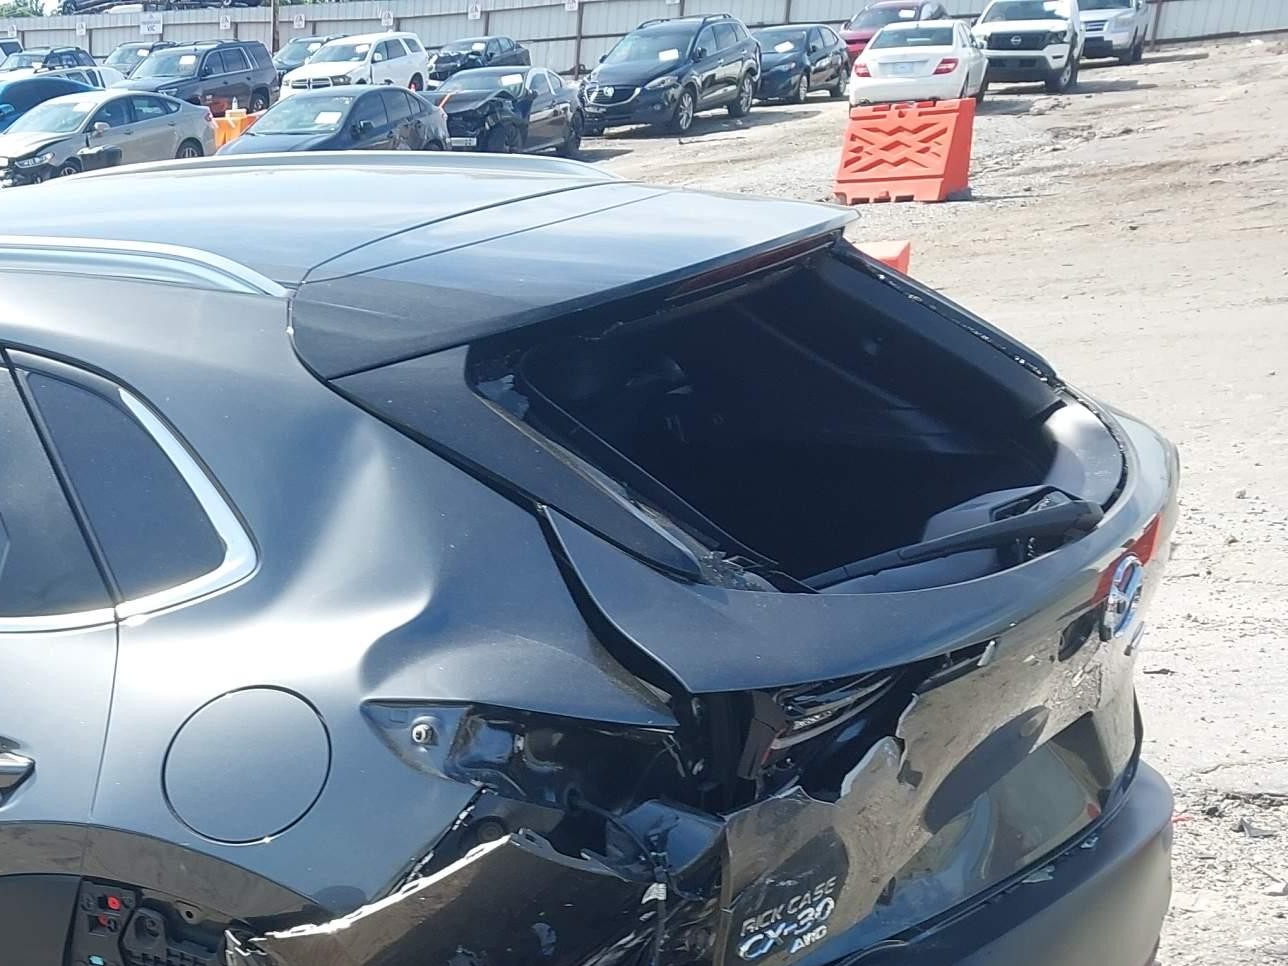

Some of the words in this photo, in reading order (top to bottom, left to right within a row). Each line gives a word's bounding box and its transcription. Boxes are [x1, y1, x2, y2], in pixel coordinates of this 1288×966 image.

[739, 896, 835, 960] CX-30
[740, 904, 786, 937] RICK
[787, 876, 837, 915] CASE
[790, 925, 828, 954] AWD
